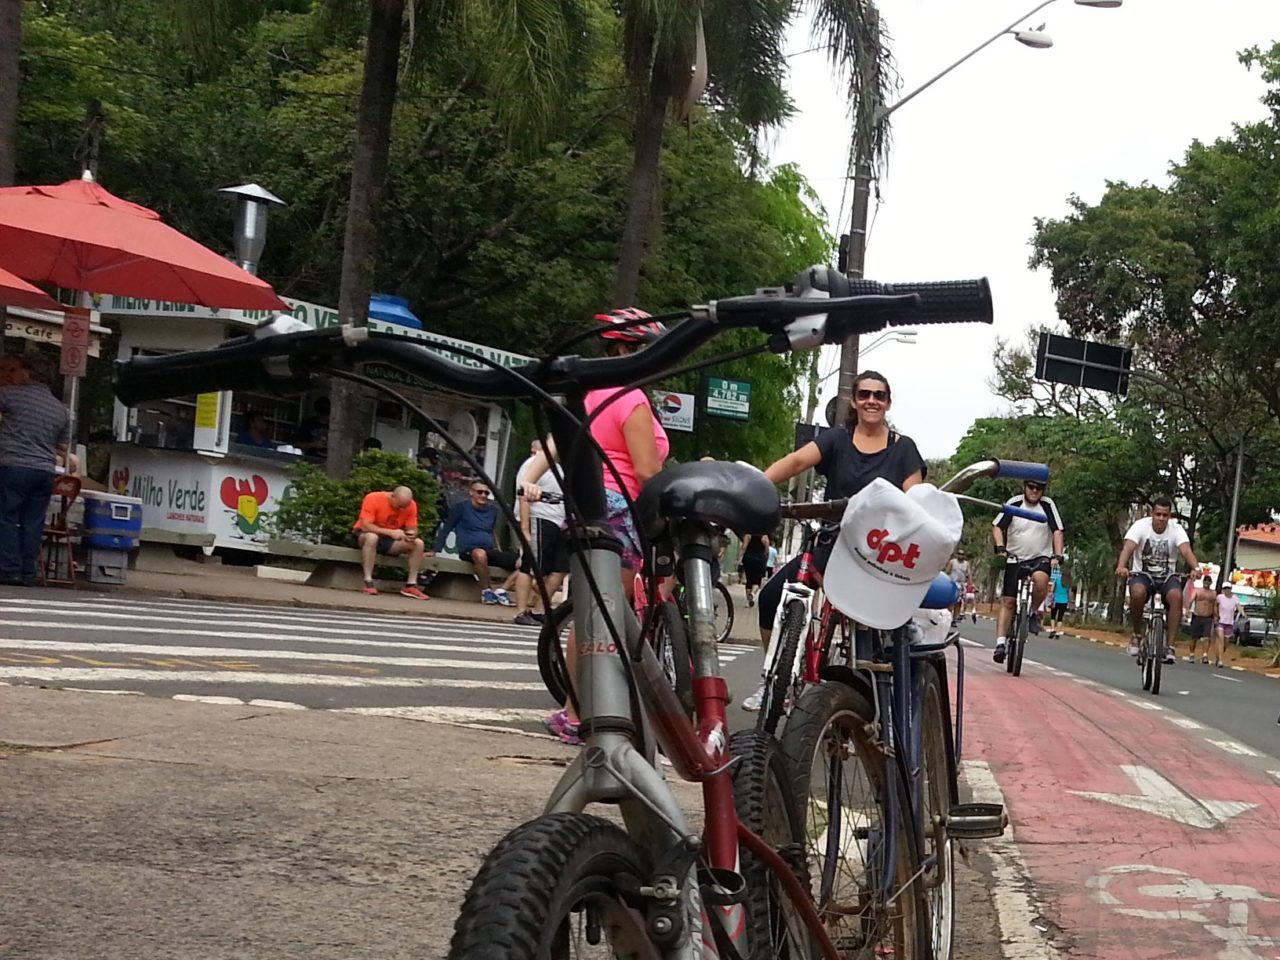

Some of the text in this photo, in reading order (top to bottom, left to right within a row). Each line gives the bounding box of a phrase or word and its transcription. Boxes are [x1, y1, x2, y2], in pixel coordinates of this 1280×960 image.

[730, 383, 738, 391] m
[132, 476, 206, 512] Milho Verde
